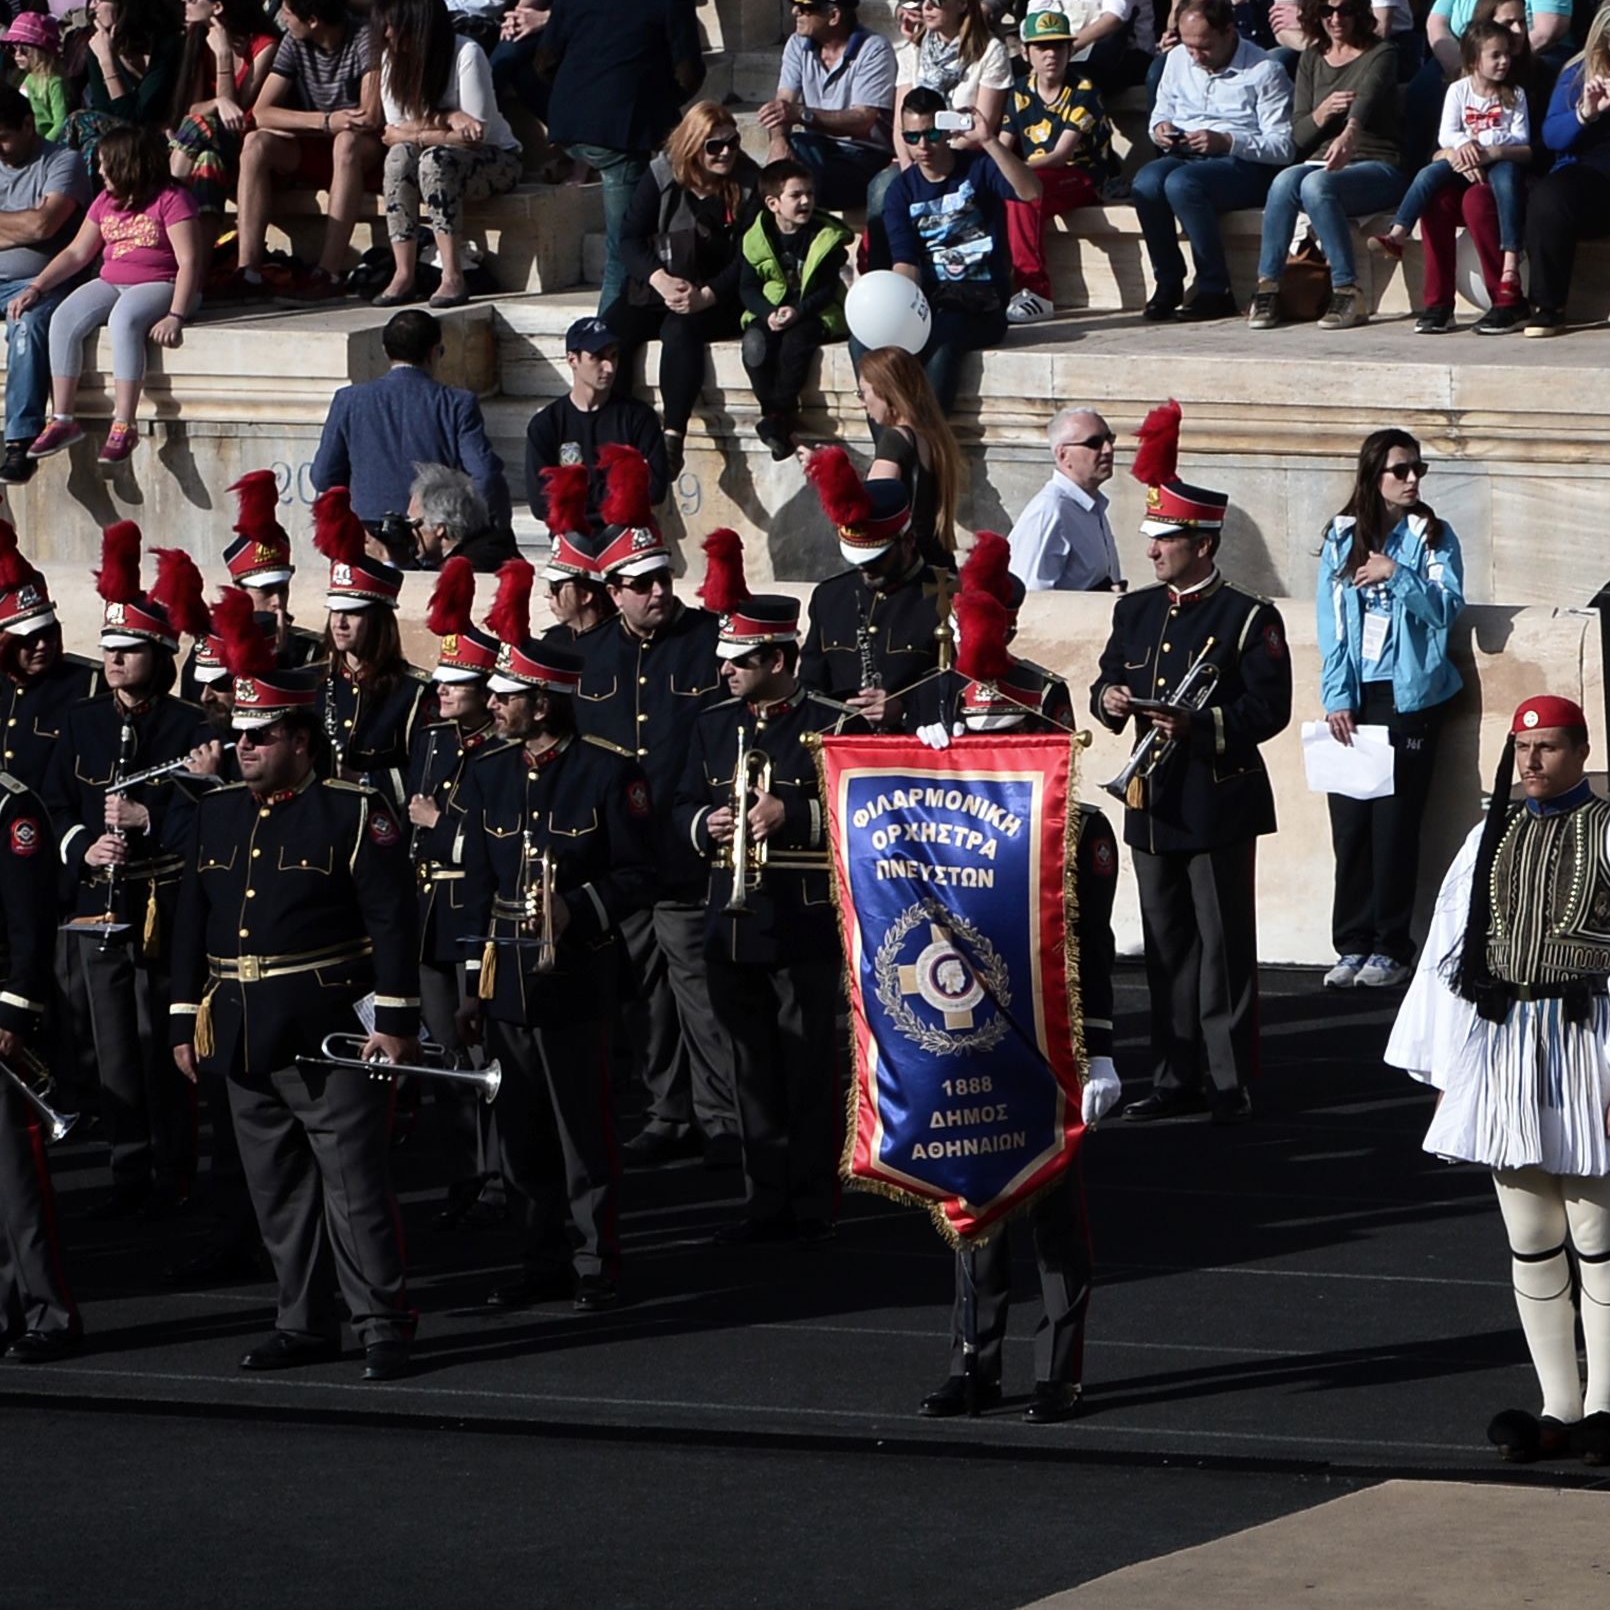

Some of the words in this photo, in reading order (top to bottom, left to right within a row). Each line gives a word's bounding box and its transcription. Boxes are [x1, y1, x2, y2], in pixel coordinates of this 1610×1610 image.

[853, 787, 1022, 837] ΦΙΛΑΡΜΟΝΙΚΗ
[872, 821, 999, 860] ΟΡΧΗΣΤΡΑ
[876, 860, 995, 888] ΠΝΕΥΣΤΩΝ
[941, 1076, 992, 1097] 1888
[930, 1103, 1009, 1128] ΔΗΜΟΣ
[911, 1131, 1026, 1161] ΑΘΗΝΑΙΩΝ
